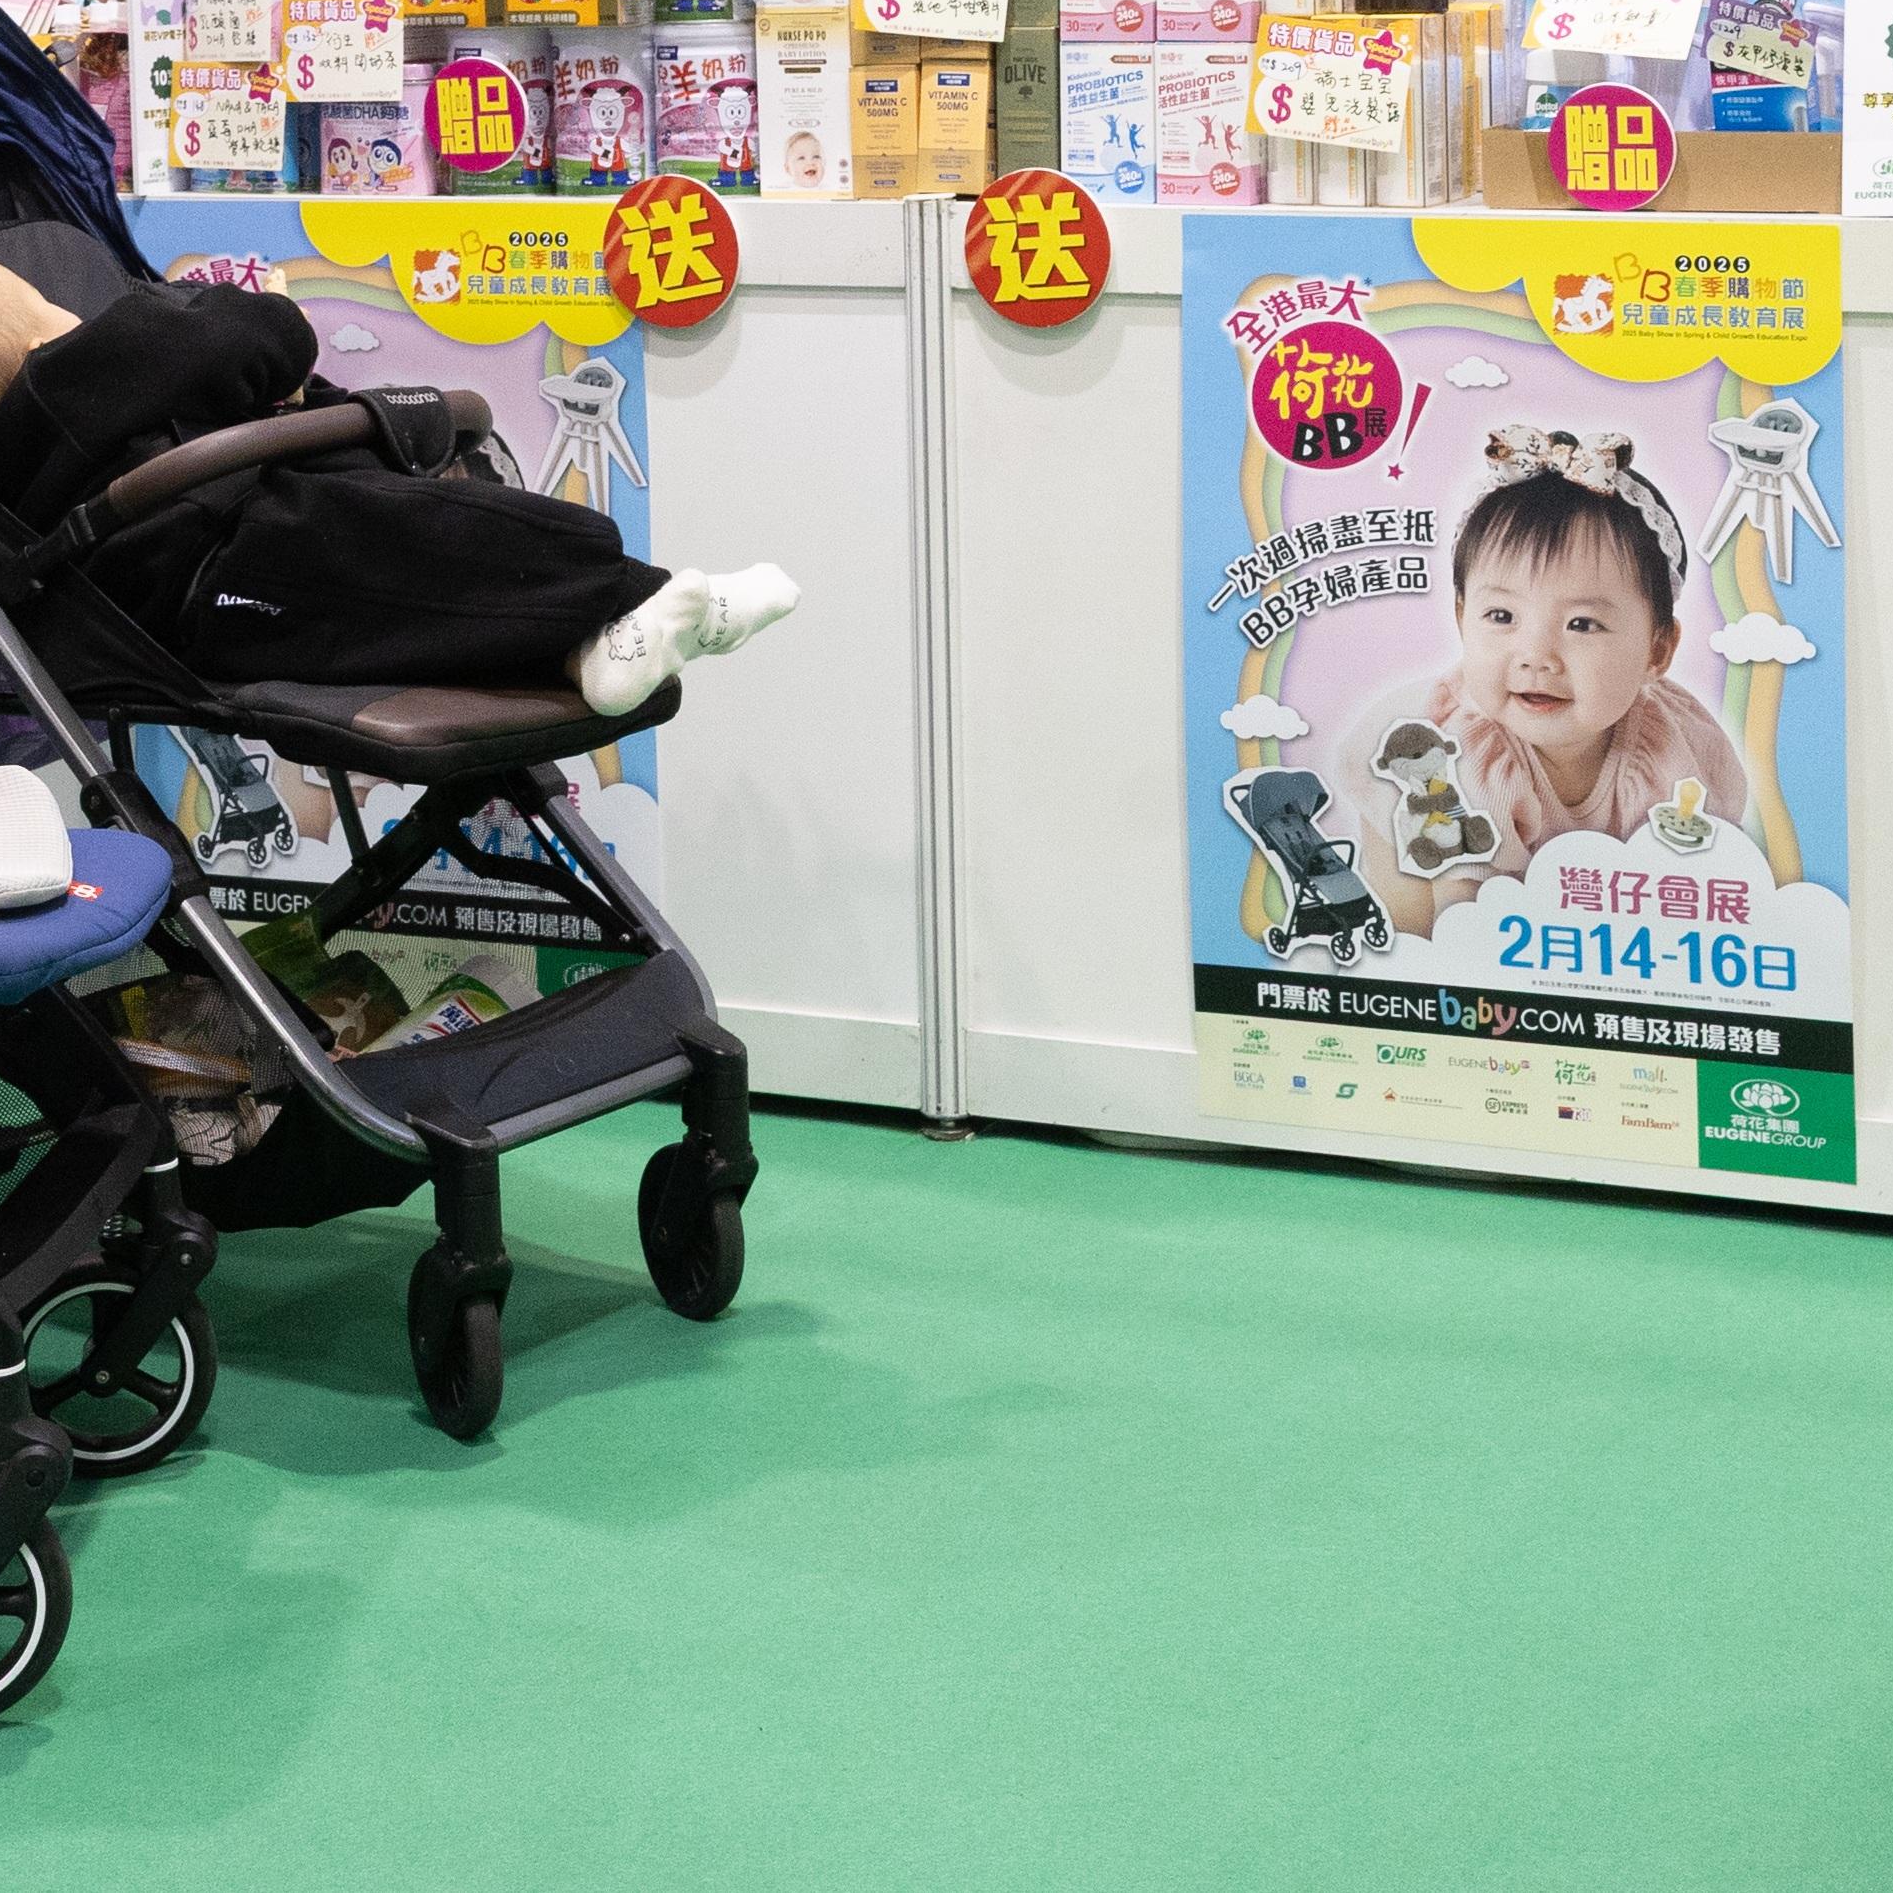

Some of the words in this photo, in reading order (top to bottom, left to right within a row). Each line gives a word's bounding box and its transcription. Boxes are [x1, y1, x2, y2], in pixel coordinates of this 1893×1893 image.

[289, 0, 357, 22] 特價貨品
[1718, 1, 1773, 29] 特價貨品
[1268, 22, 1355, 57] 特價貨品
[1004, 65, 1047, 85] OLIVE
[1067, 70, 1144, 95] PROBIOTICS
[1158, 70, 1236, 96] PROBIOTICS
[857, 97, 896, 109] VITAMIN
[927, 90, 967, 103] VITAMIN
[936, 101, 969, 112] 500MG
[438, 76, 513, 155] 贈品
[866, 108, 899, 119] 500MG
[1565, 105, 1658, 191] 贈品
[509, 231, 569, 247] 2025
[618, 192, 723, 309] 送
[983, 191, 1090, 303] 送
[1675, 255, 1750, 273] 2025
[1222, 279, 1369, 353] 全港最大
[1621, 303, 1805, 330] 兒童成長教育展
[1269, 336, 1375, 415] 荷花
[1208, 509, 1437, 614] 一次過掃盡至抵
[1240, 555, 1432, 648] BB孕婦產品
[1559, 866, 1752, 924] 灣仔會展
[1498, 913, 1797, 992] 2月14-16日
[1257, 982, 1332, 1013] 門票於
[1594, 1012, 1781, 1056] 預售及現場發售
[1731, 1114, 1801, 1134] 荷花集團
